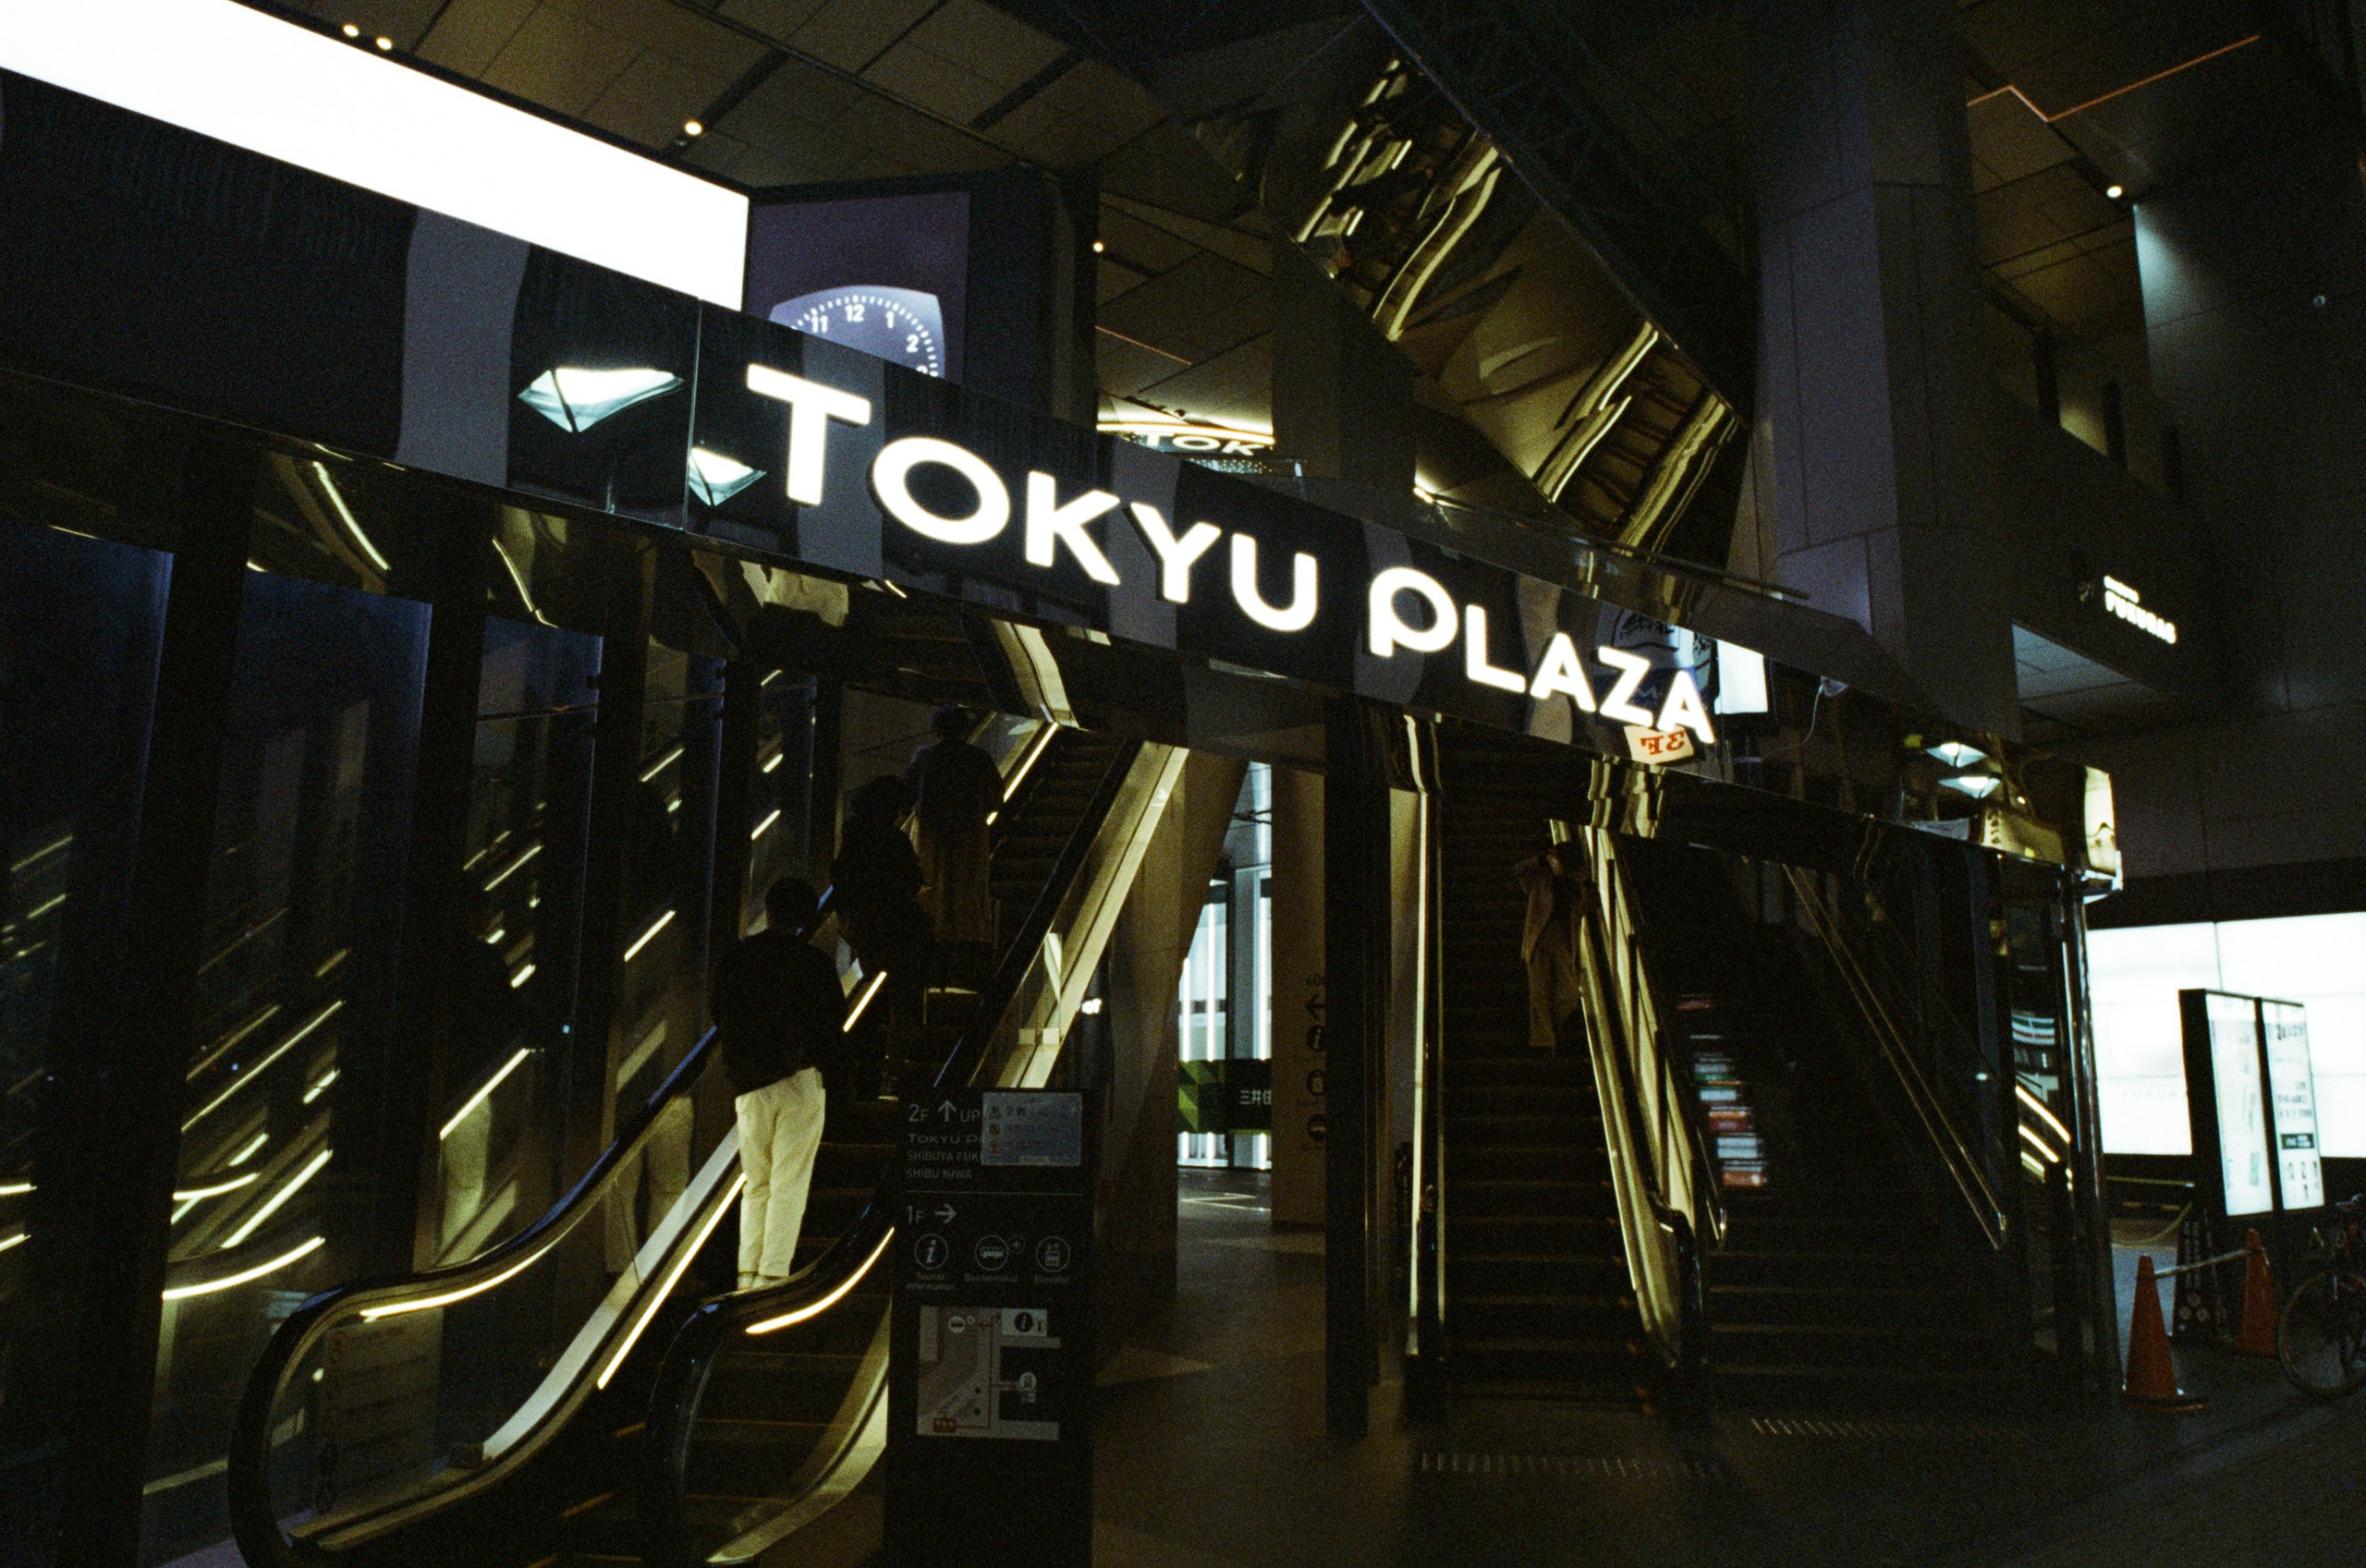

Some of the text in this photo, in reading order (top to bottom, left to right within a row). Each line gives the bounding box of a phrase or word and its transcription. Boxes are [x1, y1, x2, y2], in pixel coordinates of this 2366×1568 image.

[845, 303, 866, 323] 12
[885, 310, 896, 330] 1
[810, 314, 830, 334] 11
[906, 334, 921, 353] 2
[746, 362, 1715, 746] TOKYU PLAZA
[908, 1102, 981, 1123] 2F UP
[907, 1133, 960, 1145] TOKYU
[906, 1204, 924, 1224] 1F
